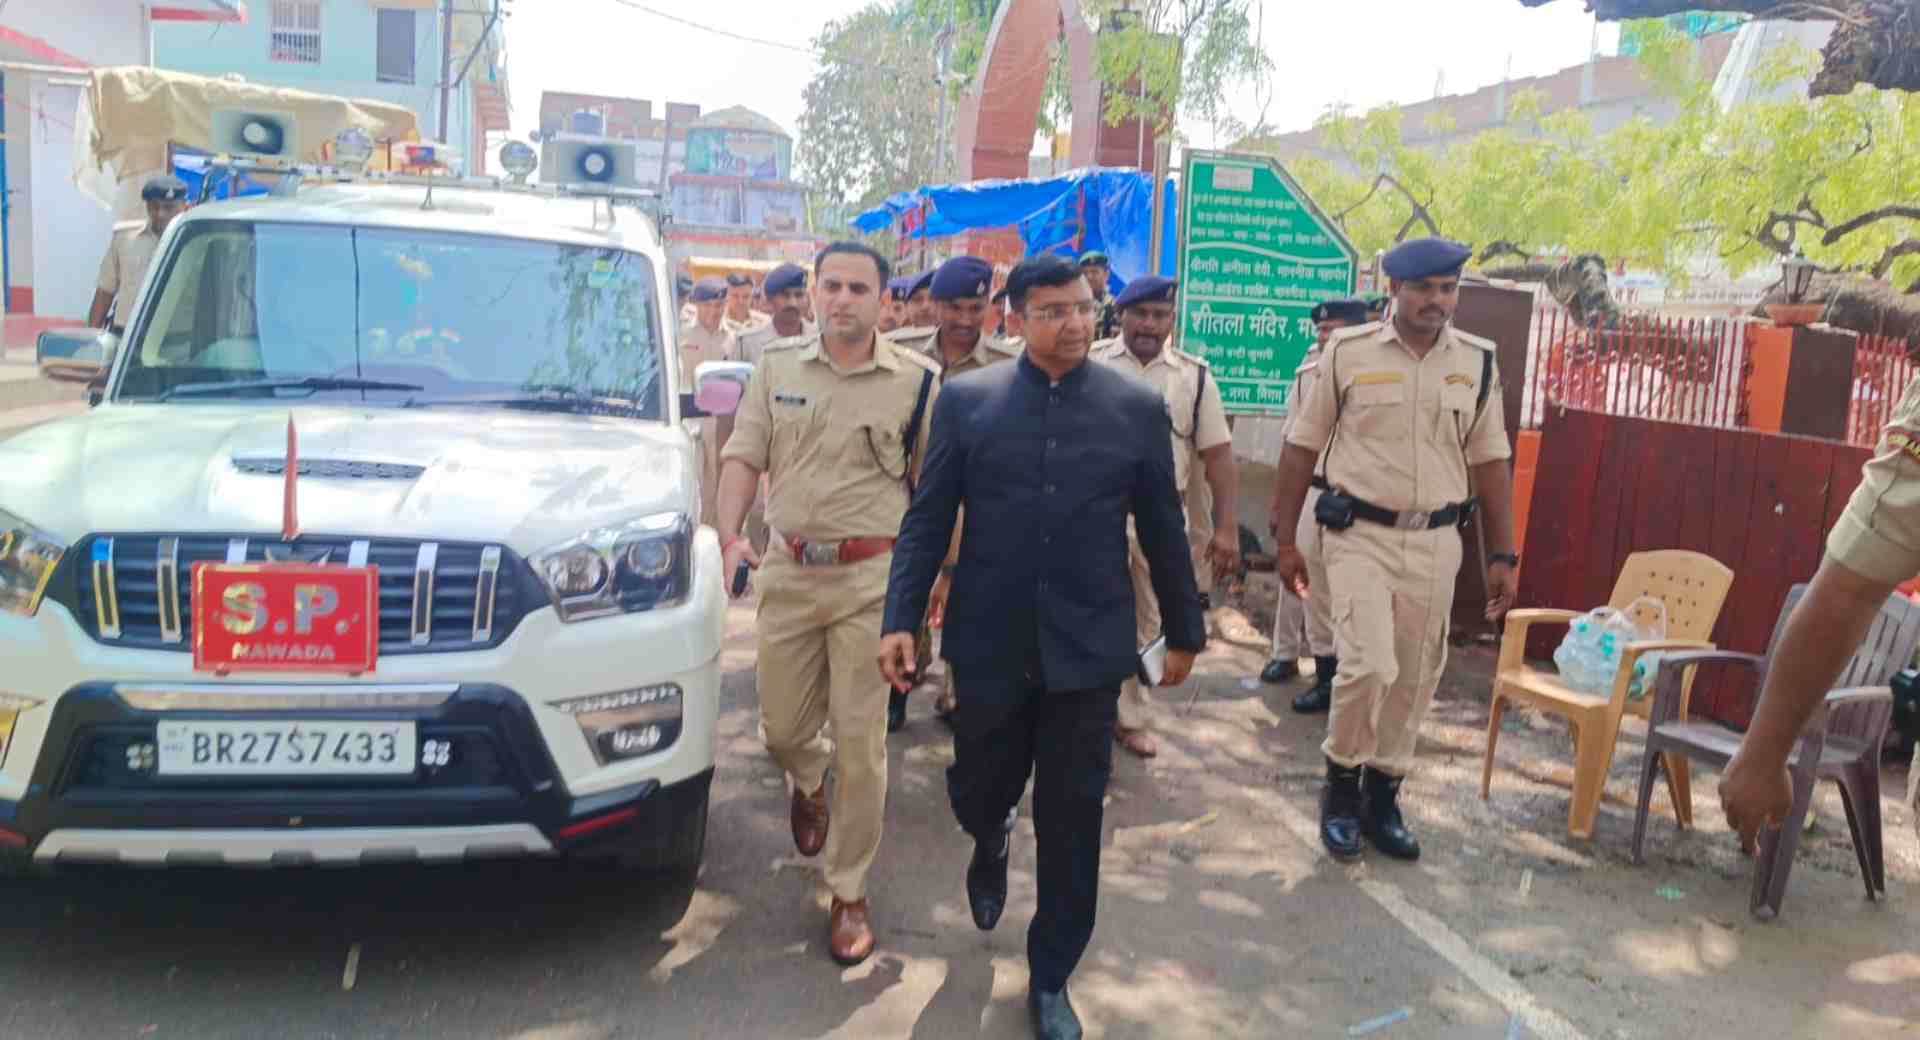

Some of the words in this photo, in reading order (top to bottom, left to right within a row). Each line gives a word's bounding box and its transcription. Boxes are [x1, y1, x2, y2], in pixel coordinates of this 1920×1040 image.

[1191, 303, 1245, 336] शीतला
[1247, 306, 1292, 342] मंदिर,
[222, 581, 349, 636] S.P.
[232, 641, 336, 660] NAWADA
[192, 731, 397, 764] BR27S7433
